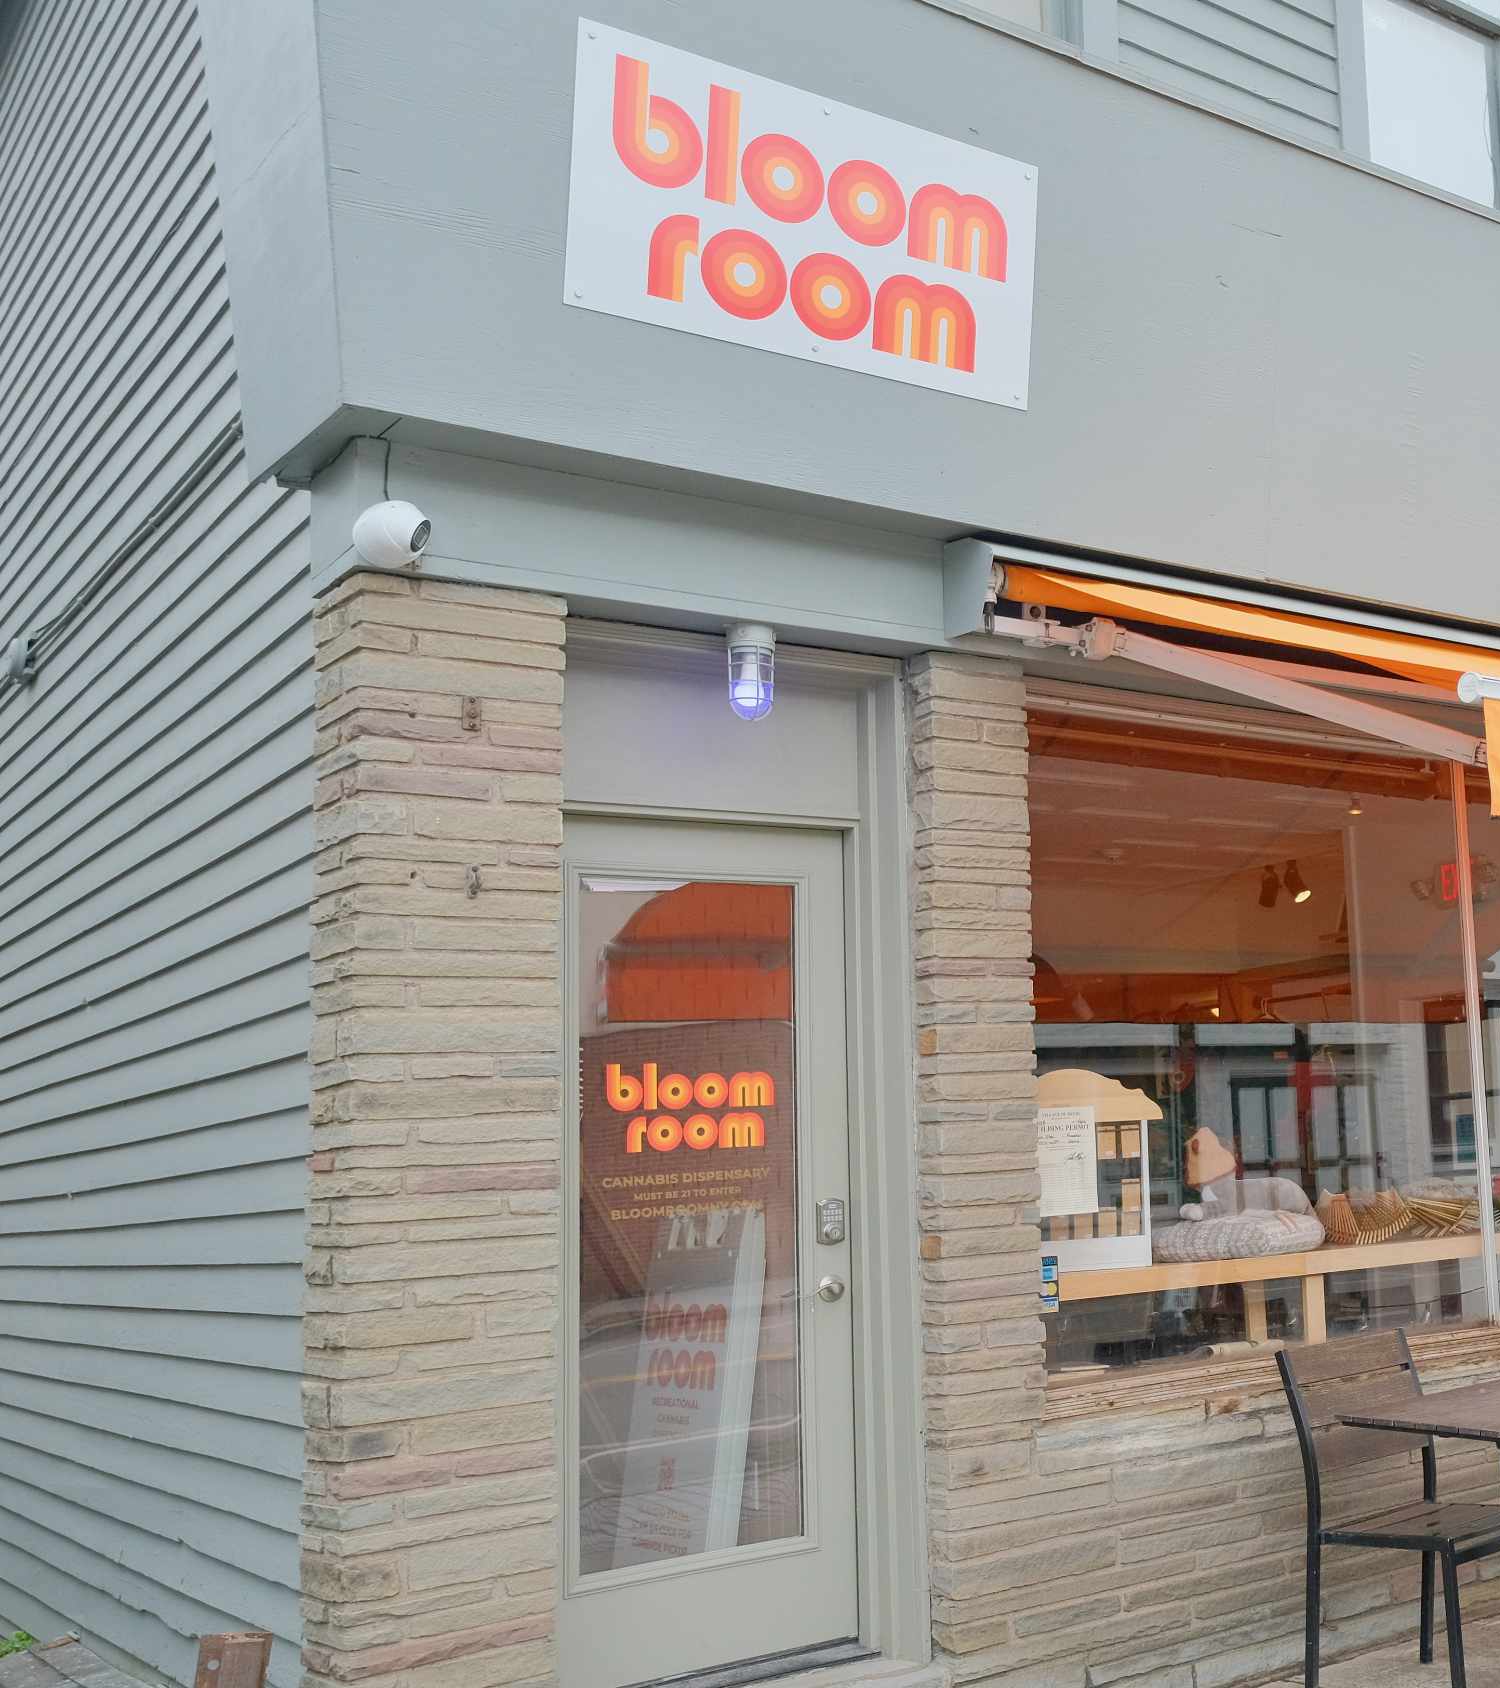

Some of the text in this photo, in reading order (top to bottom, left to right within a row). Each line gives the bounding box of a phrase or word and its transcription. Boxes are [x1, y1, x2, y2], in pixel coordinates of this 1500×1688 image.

[612, 53, 1008, 283] bloom
[647, 213, 977, 373] room
[606, 1063, 775, 1111] bloom
[626, 1112, 765, 1153] room
[602, 1167, 769, 1189] CANNABIS DISPENSARY
[633, 1185, 742, 1201] MUST BE 21 TO ENTER
[645, 1288, 727, 1343] bloom
[646, 1348, 716, 1391] room
